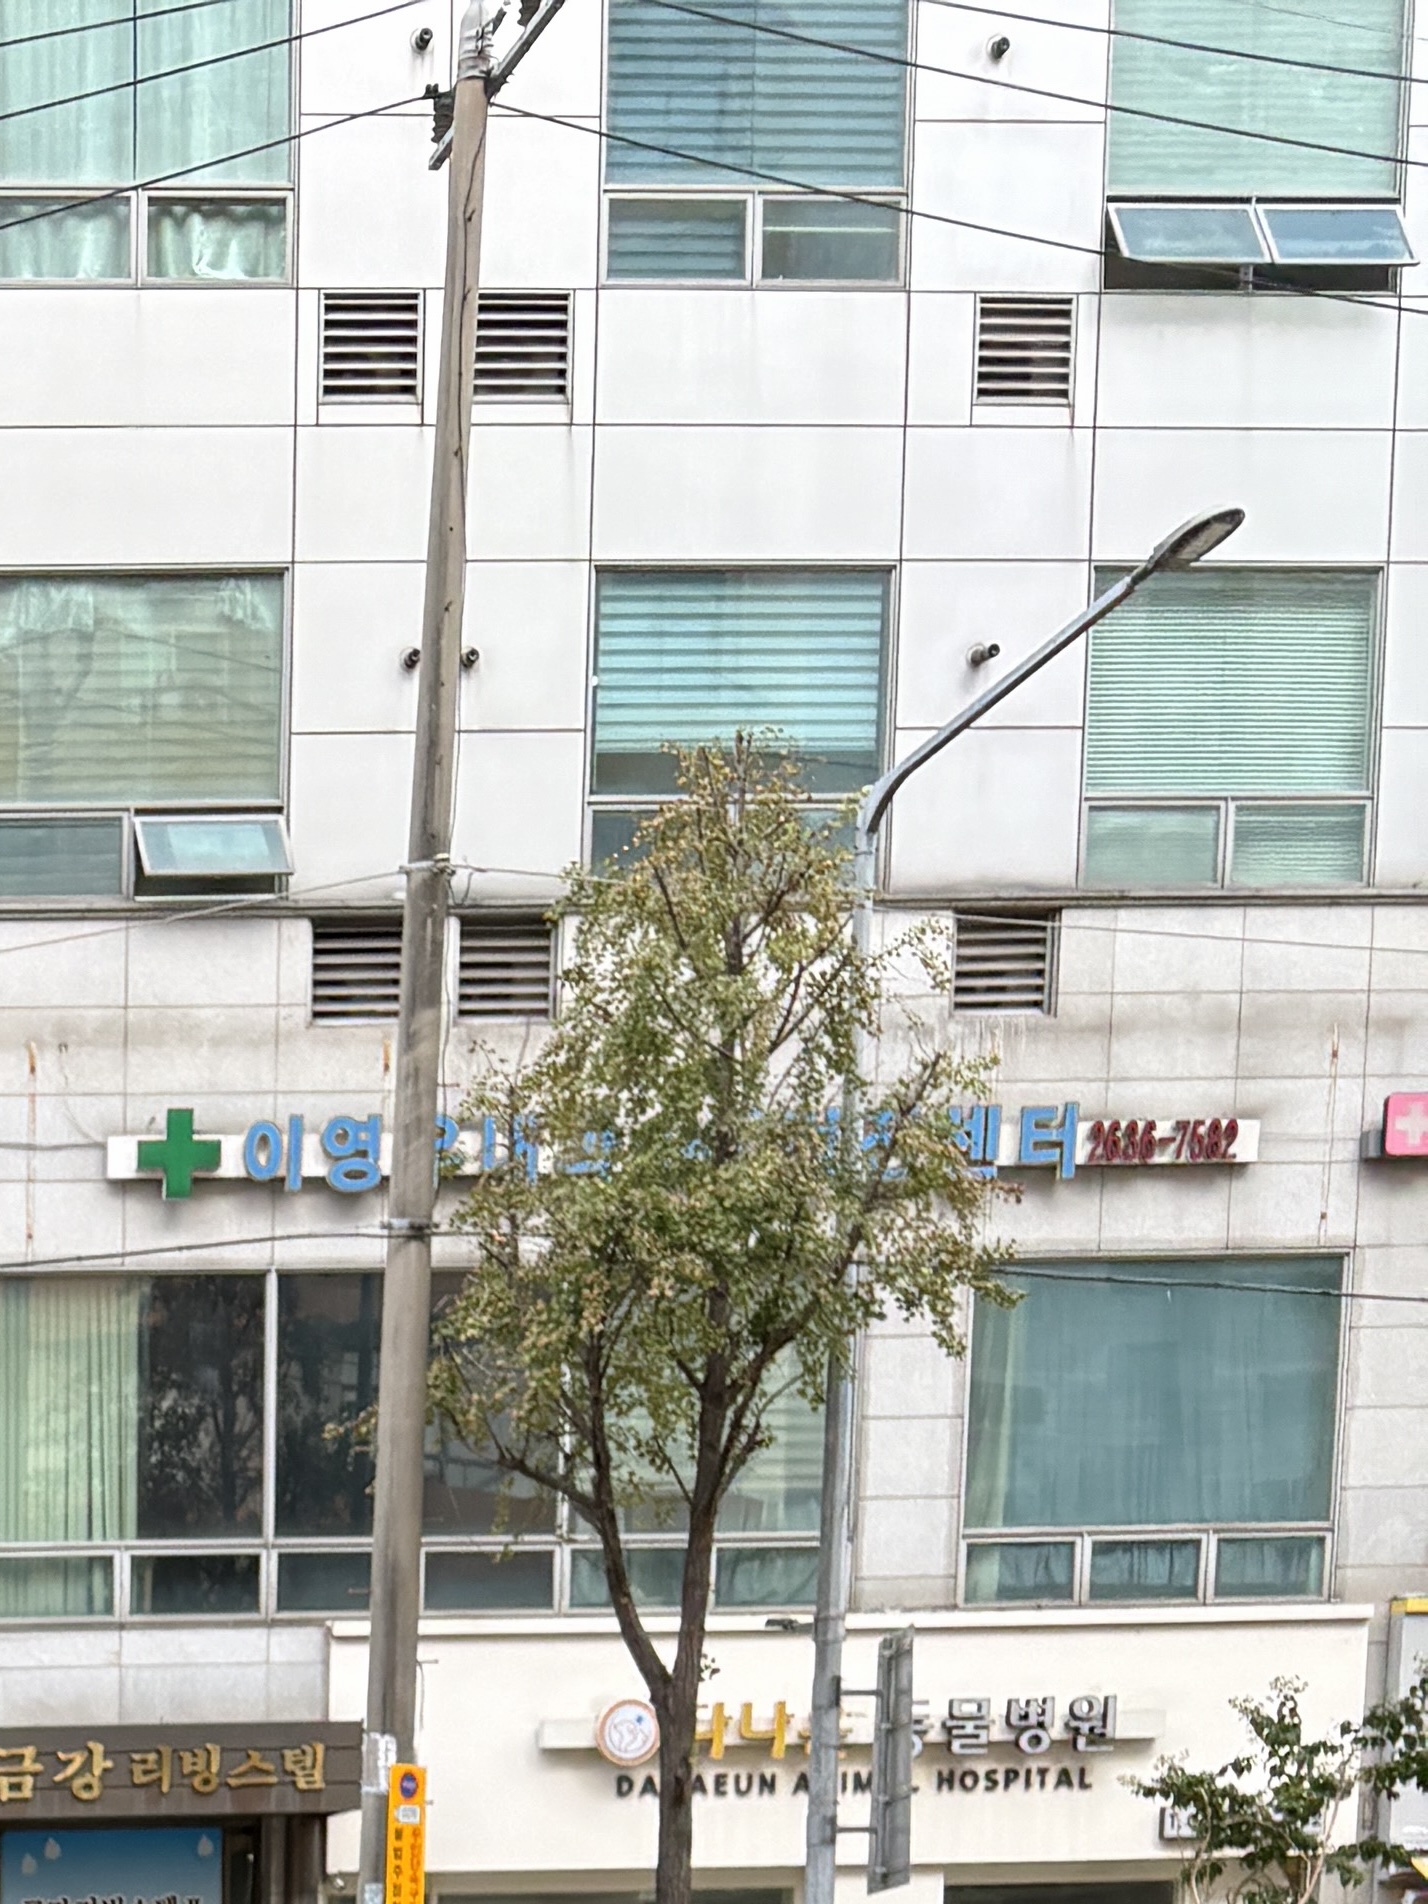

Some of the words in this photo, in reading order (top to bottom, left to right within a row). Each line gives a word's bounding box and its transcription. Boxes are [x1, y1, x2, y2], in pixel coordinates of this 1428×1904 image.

[129, 1741, 326, 1795] 리빙스텔
[616, 1772, 776, 1798] DAAEUN
[935, 1765, 1094, 1792] HOSPITAL
